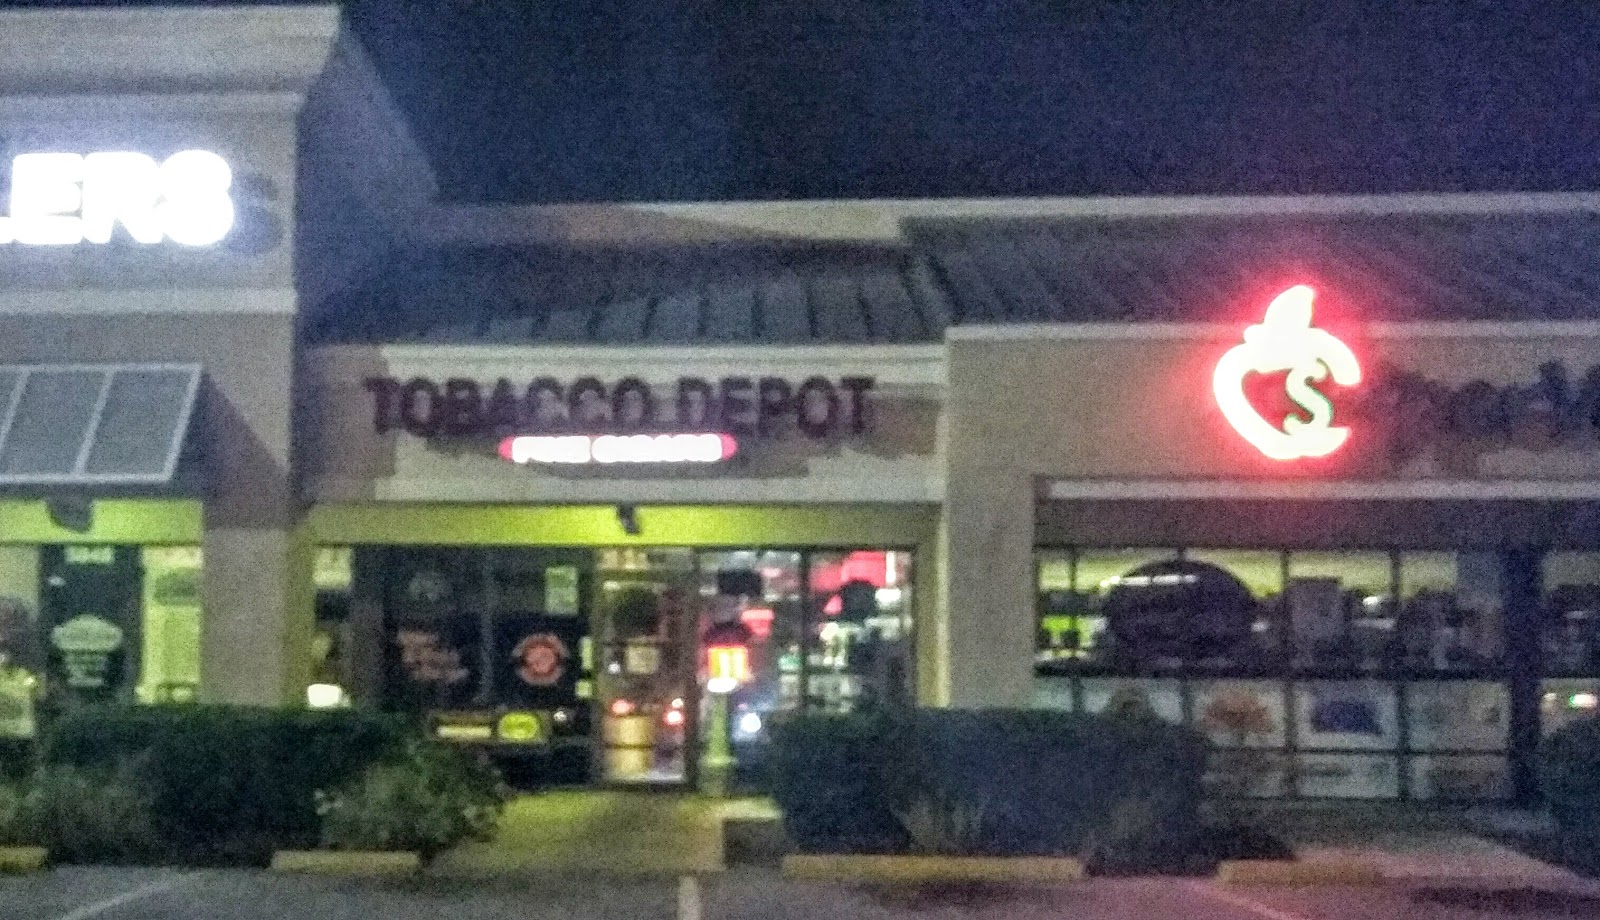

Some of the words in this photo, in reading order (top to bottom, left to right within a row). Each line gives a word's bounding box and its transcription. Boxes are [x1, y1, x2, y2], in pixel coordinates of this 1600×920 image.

[0, 150, 234, 246] ERS
[365, 376, 653, 438] TOBACCO
[677, 376, 876, 438] DEPOT
